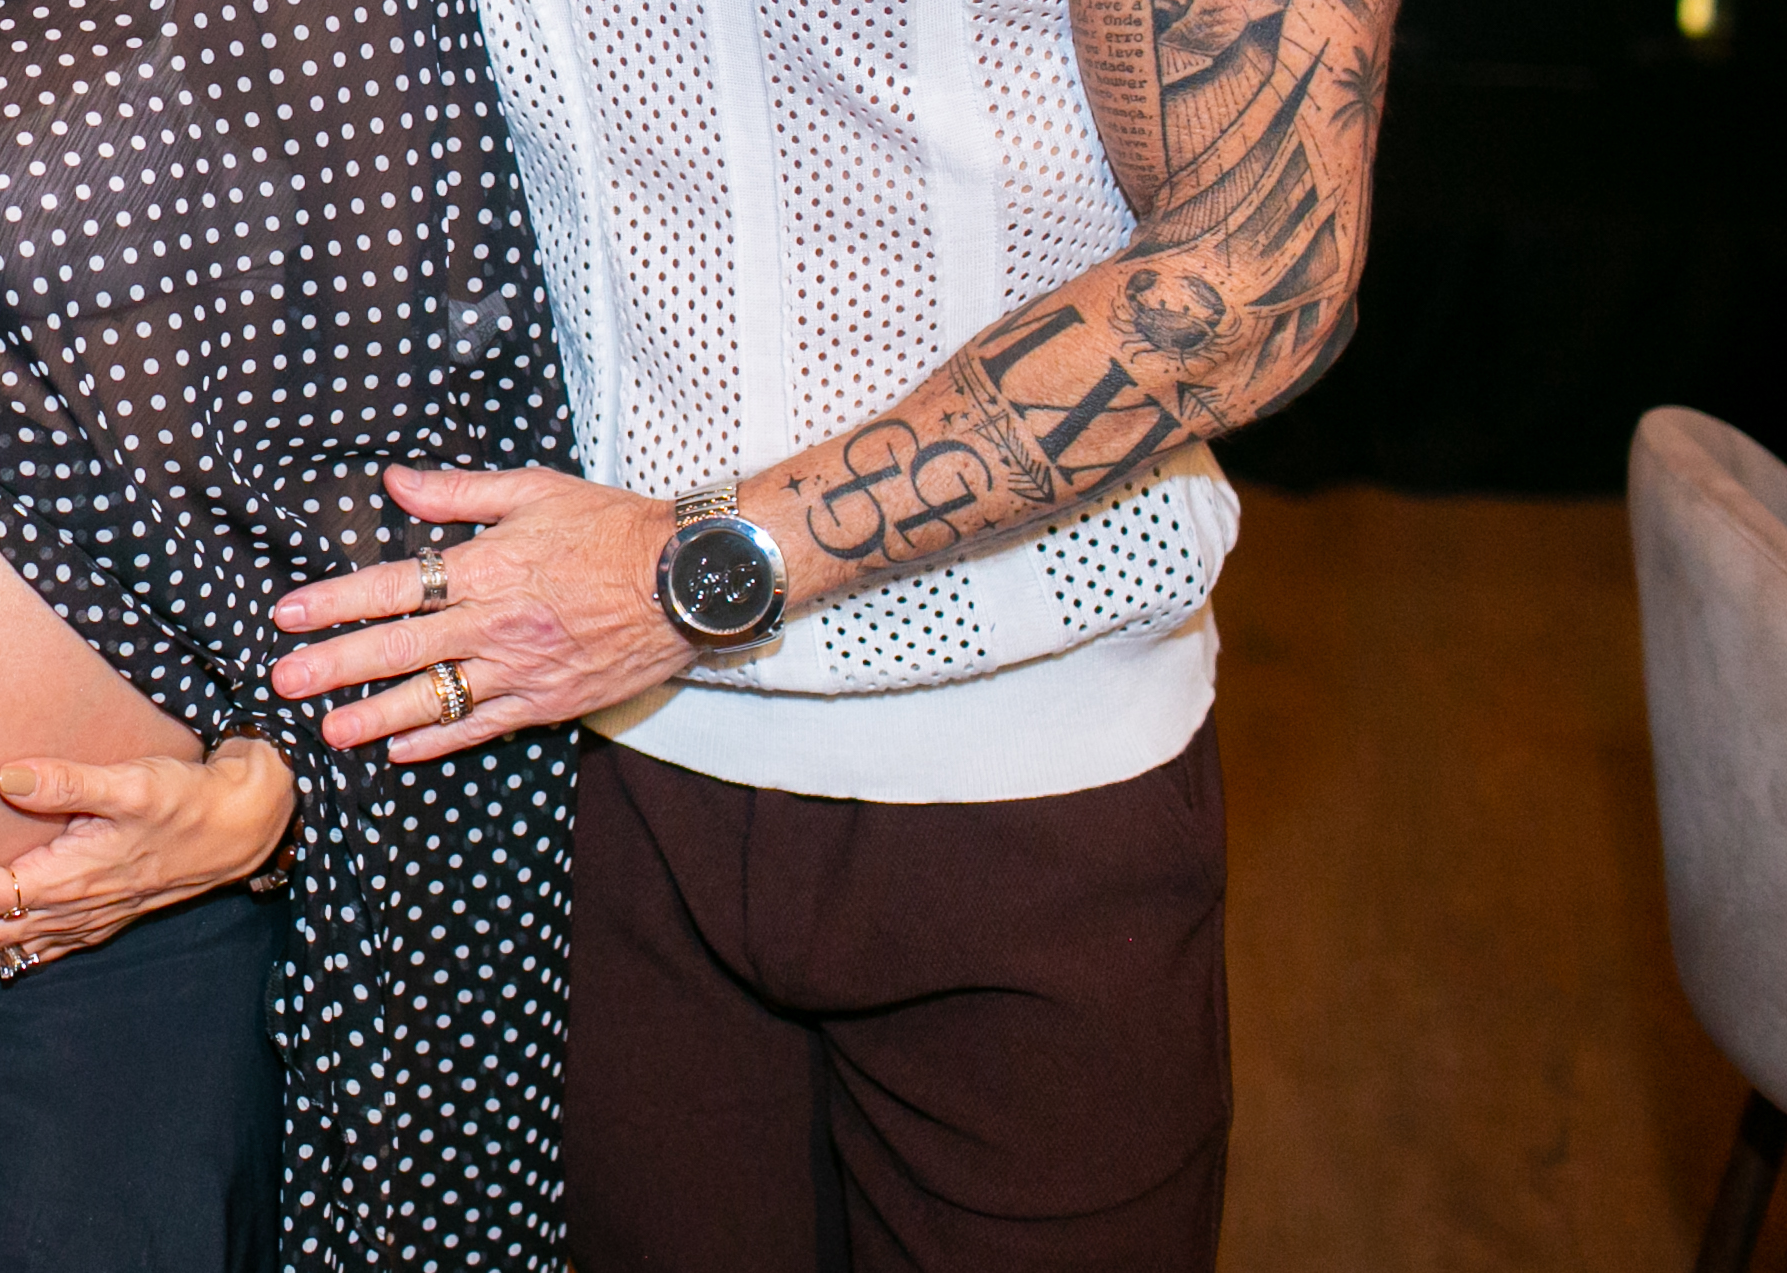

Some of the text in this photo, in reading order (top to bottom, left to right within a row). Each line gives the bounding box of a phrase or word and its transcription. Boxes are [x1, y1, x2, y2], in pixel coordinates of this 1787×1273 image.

[1103, 14, 1142, 27] Onde
[1105, 32, 1144, 43] erro
[1108, 45, 1144, 58] leve
[1121, 93, 1147, 105] que
